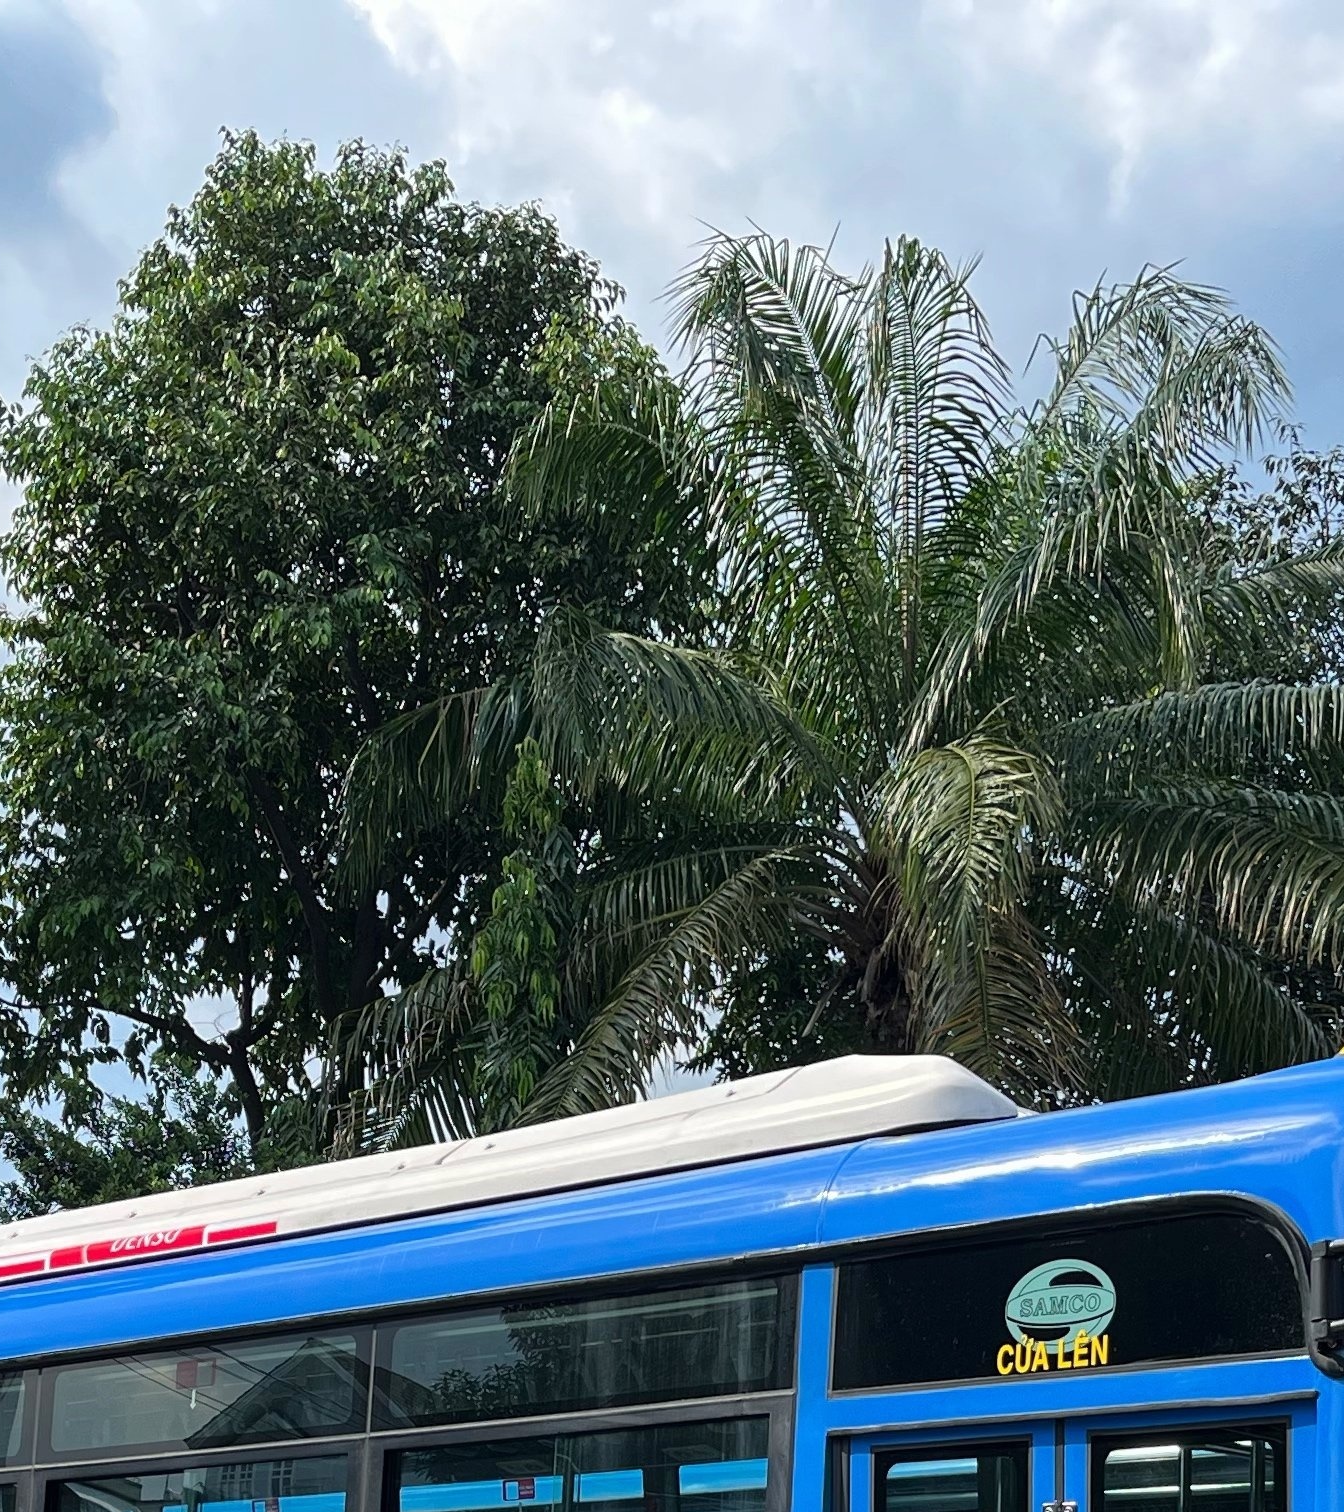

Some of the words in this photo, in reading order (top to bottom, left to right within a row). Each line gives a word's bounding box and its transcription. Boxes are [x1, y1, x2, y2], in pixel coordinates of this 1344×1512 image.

[1019, 1292, 1102, 1318] SAMCO
[997, 1333, 1050, 1375] CỬA
[1057, 1329, 1109, 1370] LÊN
